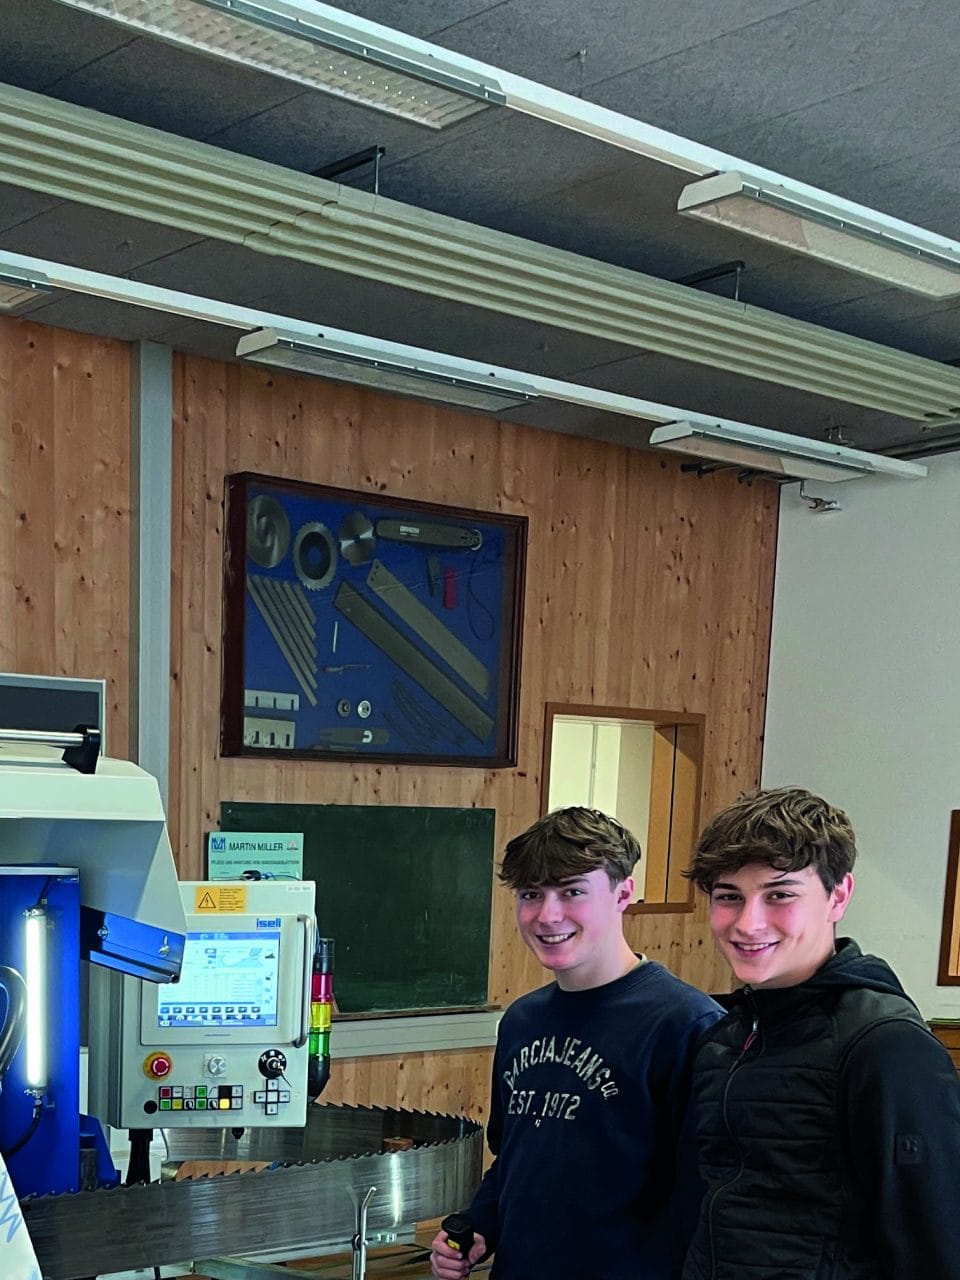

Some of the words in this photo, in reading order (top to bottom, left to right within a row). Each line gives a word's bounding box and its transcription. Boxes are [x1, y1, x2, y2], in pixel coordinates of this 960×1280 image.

[229, 842, 255, 851] MARTIN
[258, 842, 283, 851] MILLER
[503, 1036, 556, 1091] GARCIA
[555, 1036, 611, 1090] JEANS
[541, 1092, 581, 1120] 1972
